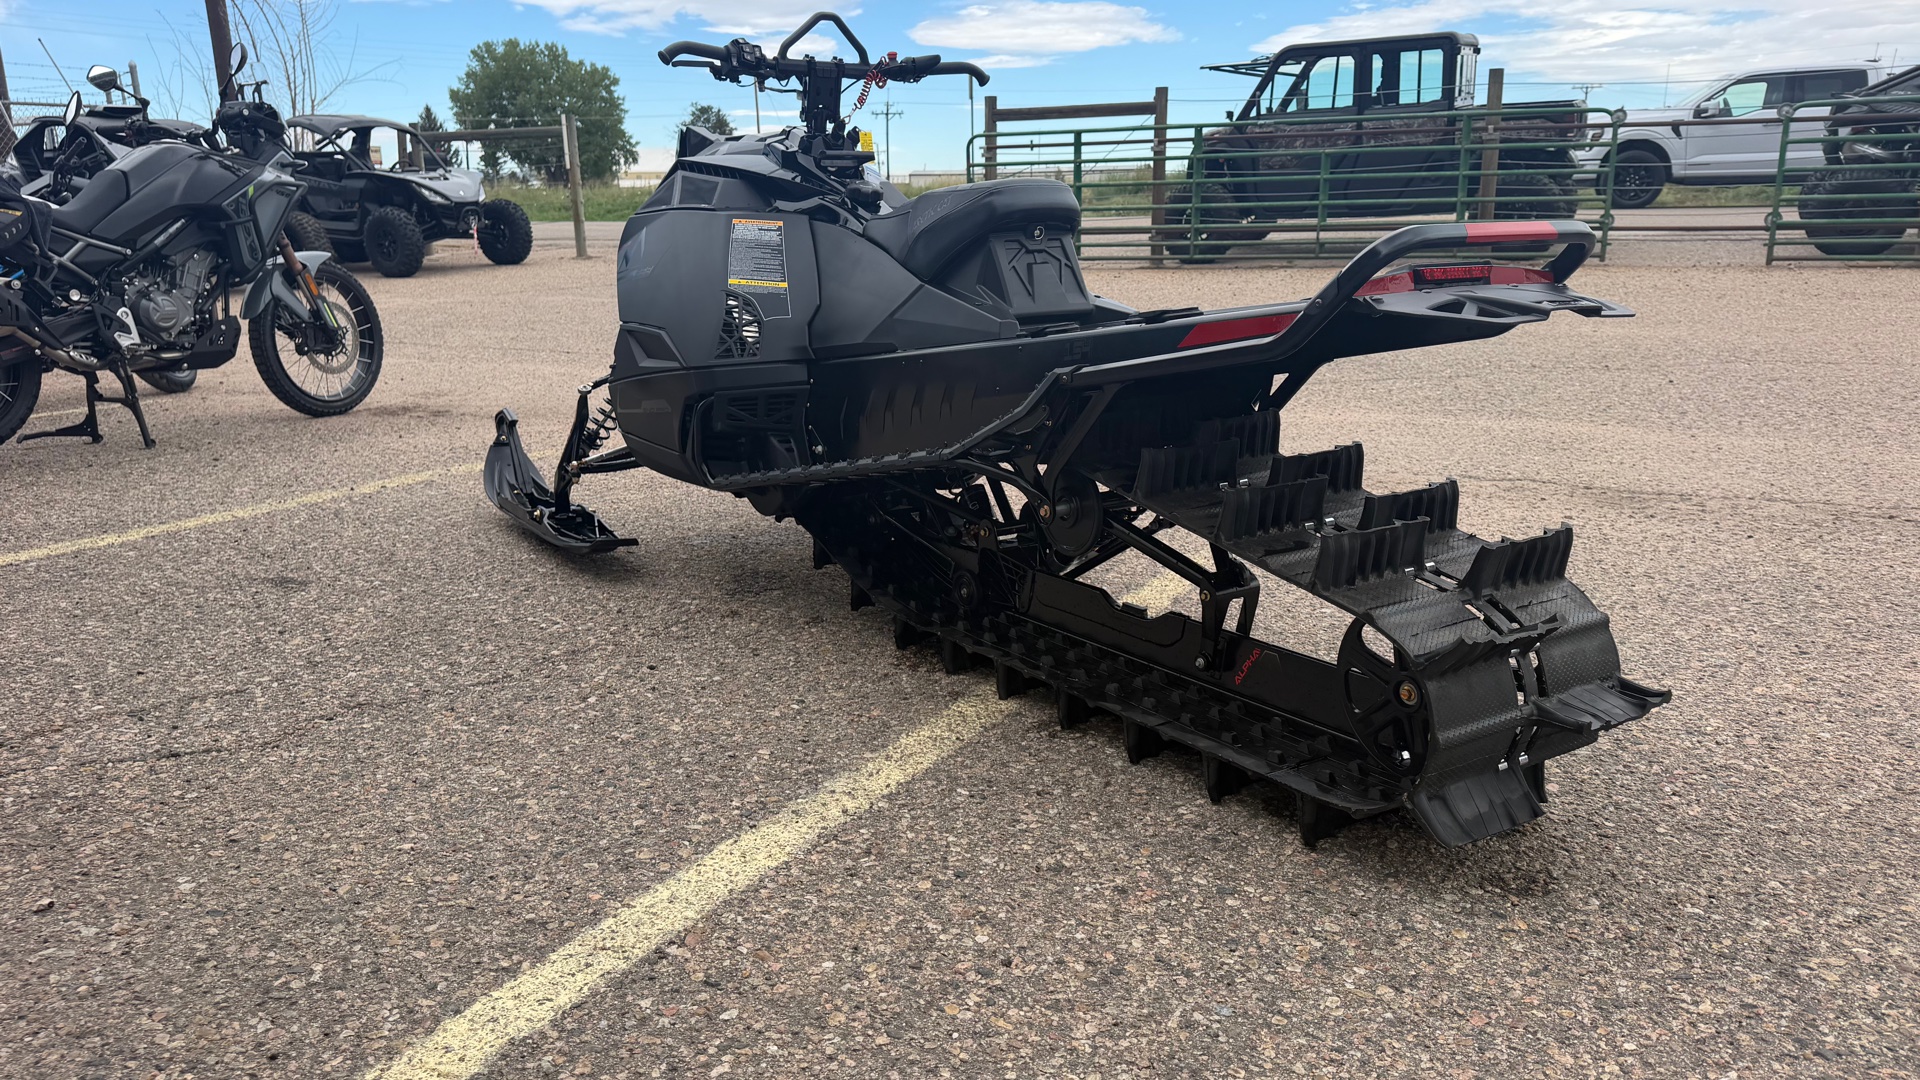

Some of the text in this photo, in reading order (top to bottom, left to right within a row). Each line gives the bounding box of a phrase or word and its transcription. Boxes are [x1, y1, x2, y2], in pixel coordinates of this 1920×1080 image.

[912, 193, 954, 230] ARCTIC CAT
[1235, 648, 1261, 685] ALPHA
